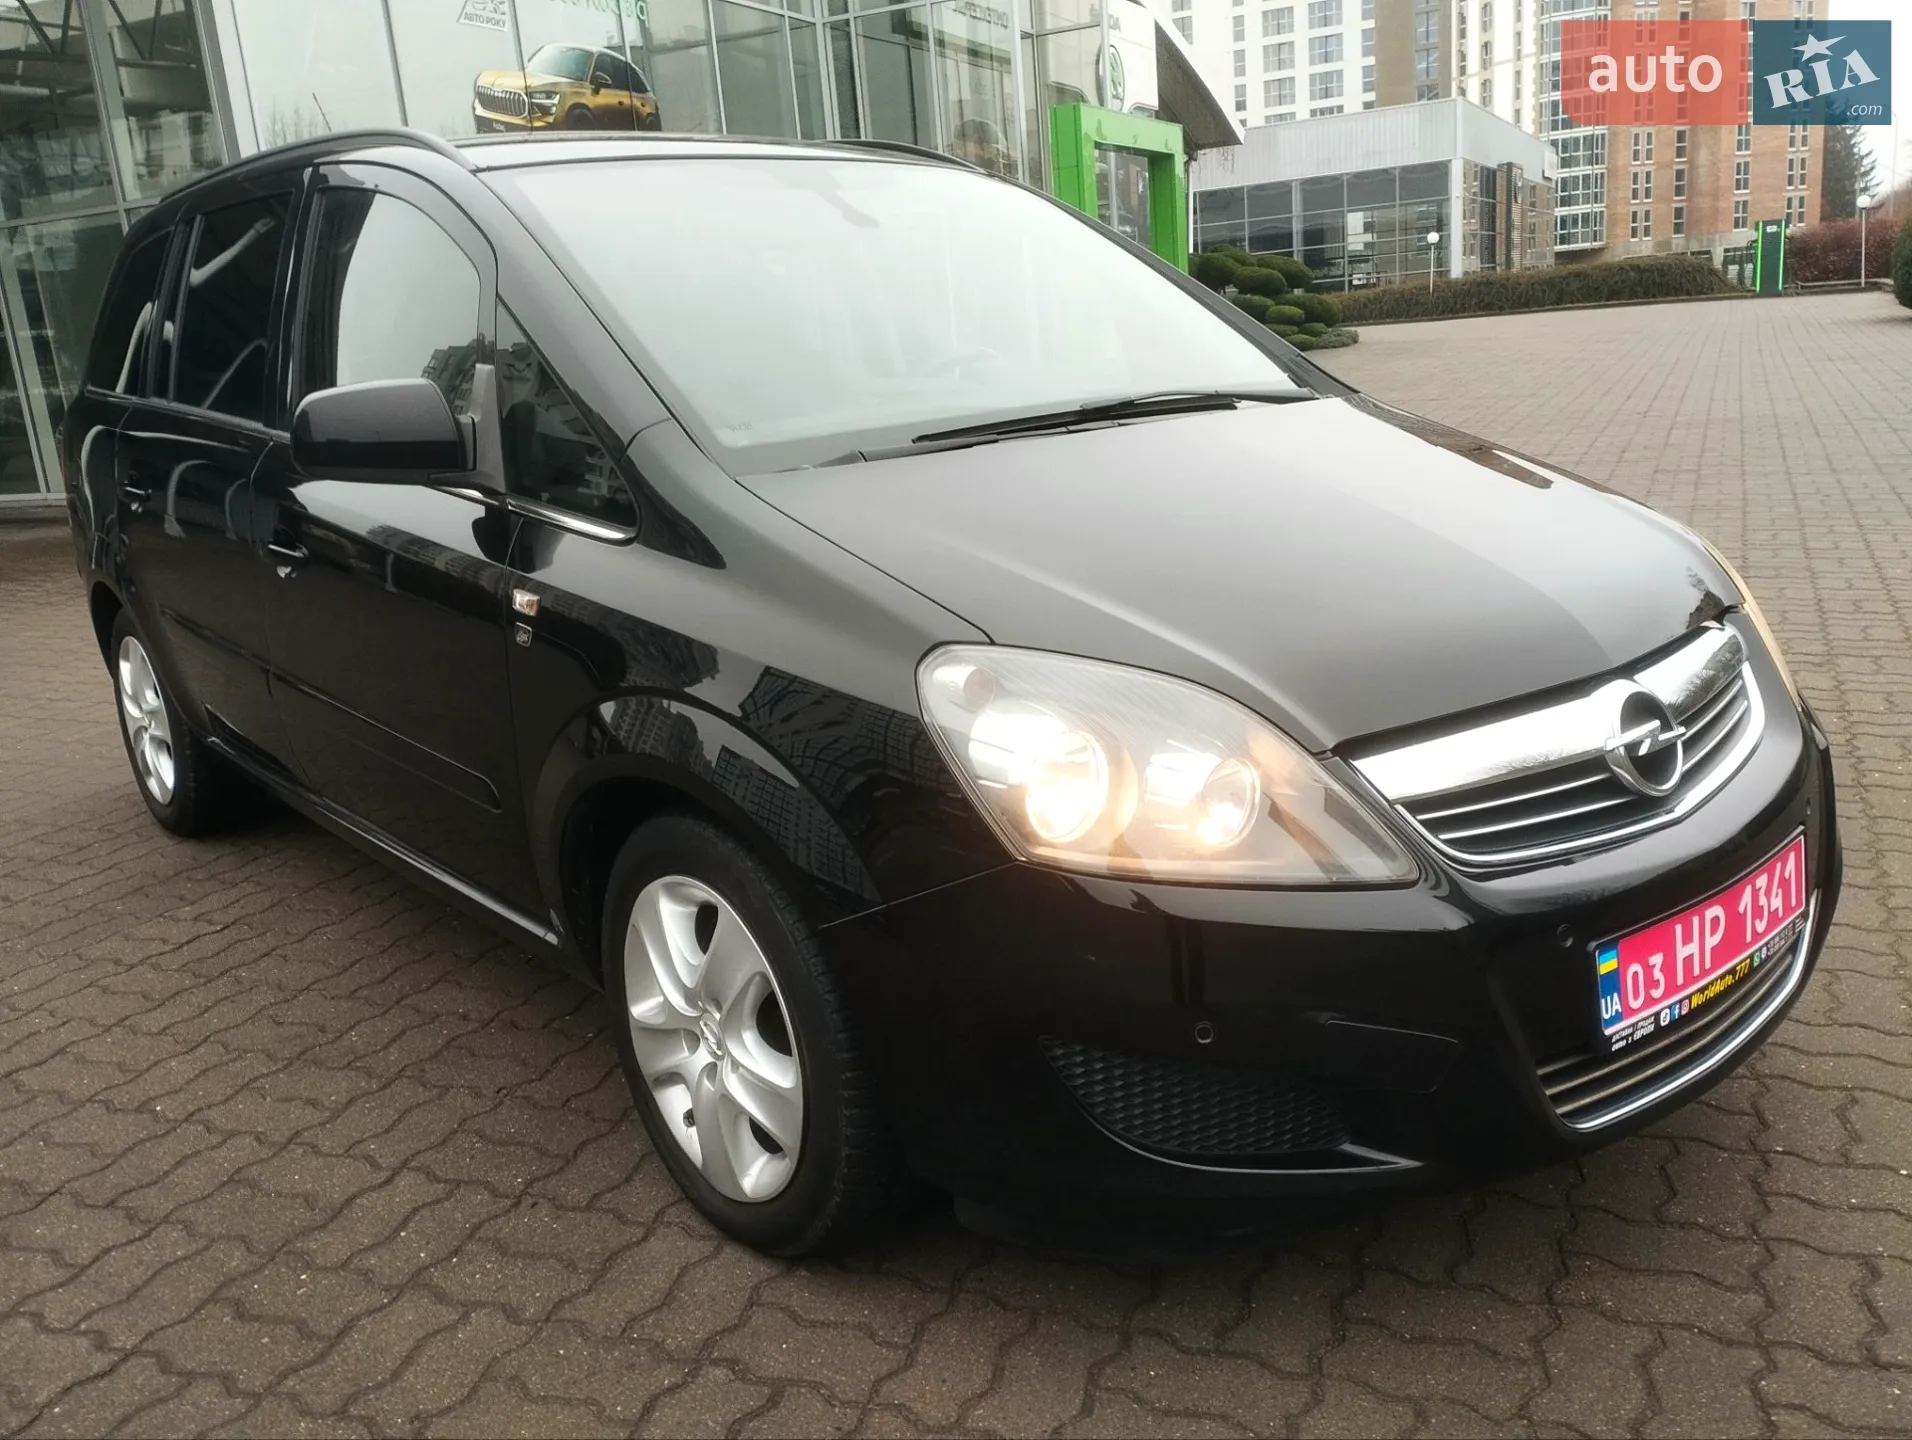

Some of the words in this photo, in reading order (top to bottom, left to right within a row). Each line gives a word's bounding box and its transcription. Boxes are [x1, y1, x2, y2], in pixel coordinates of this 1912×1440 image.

[1626, 951, 1666, 1010] 03
[1675, 904, 1726, 987] HP
[1737, 850, 1797, 944] 1341
[1601, 992, 1622, 1020] UA
